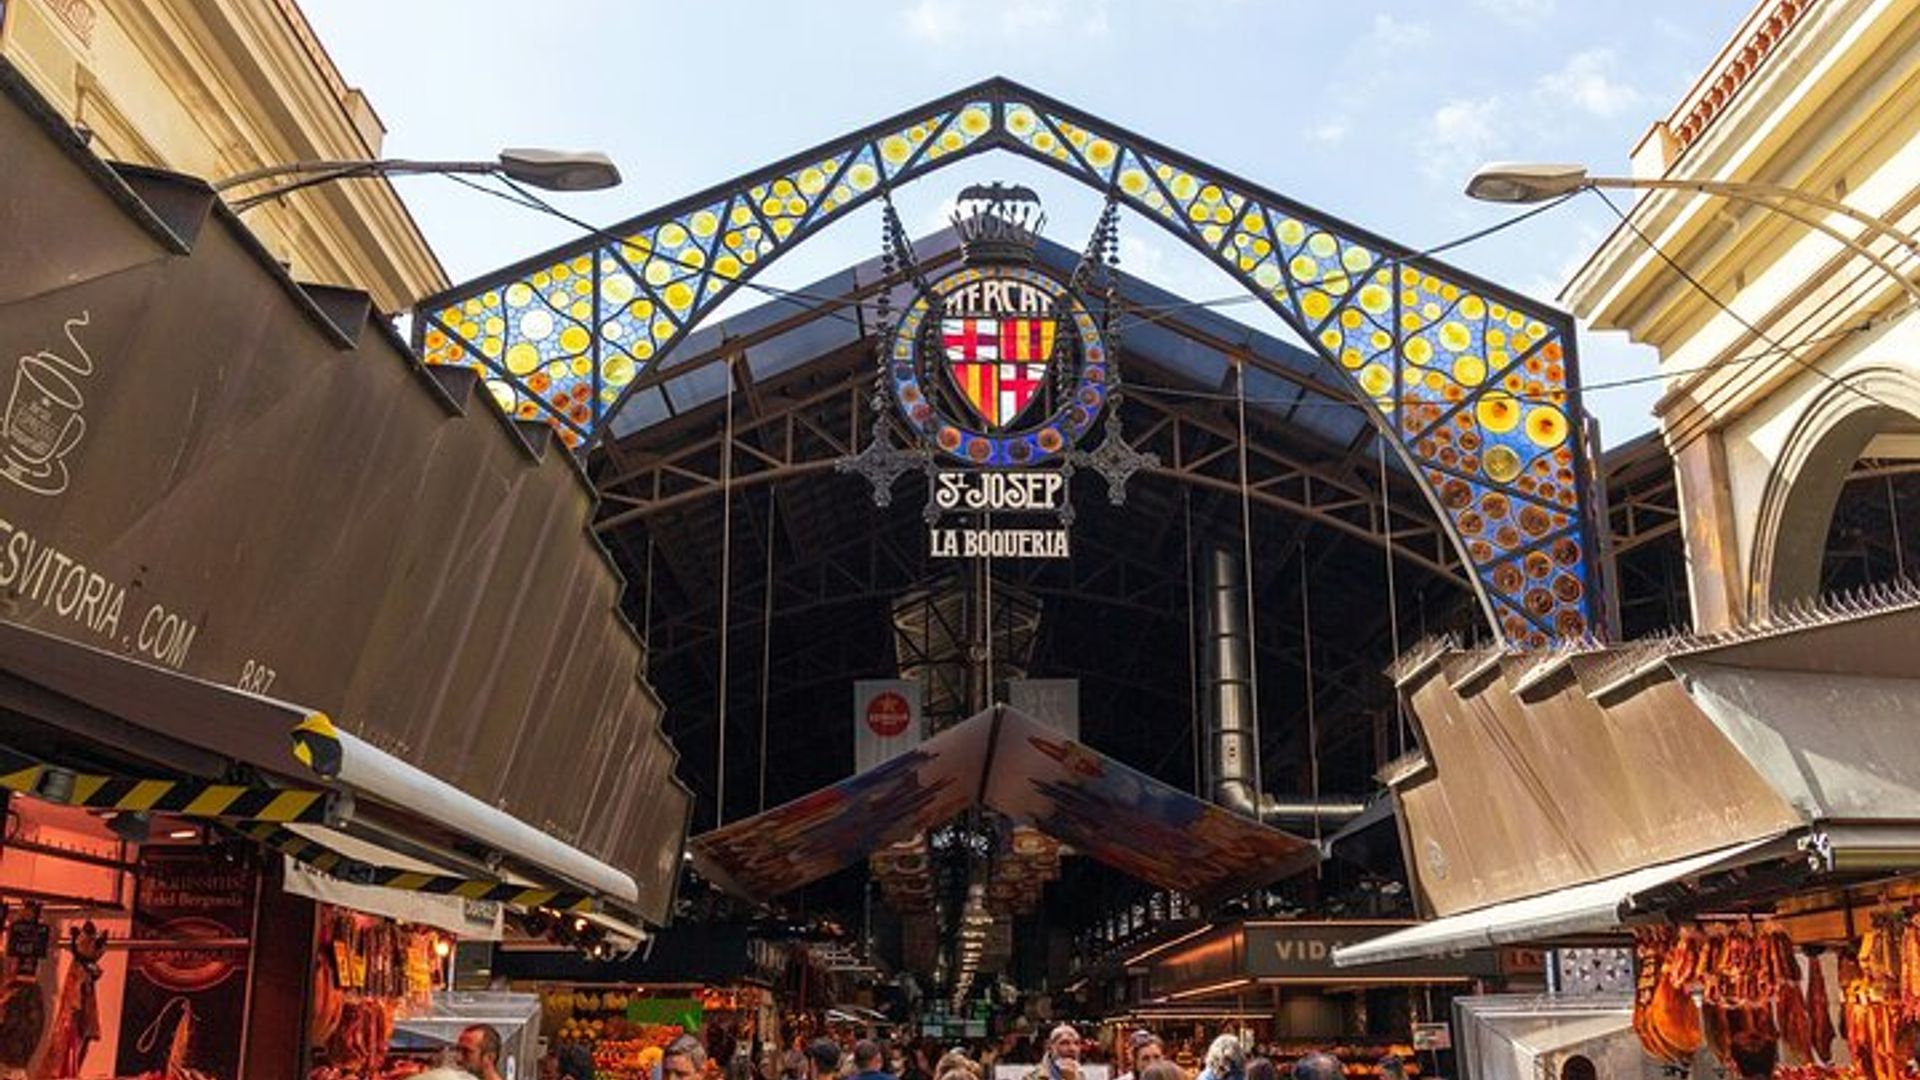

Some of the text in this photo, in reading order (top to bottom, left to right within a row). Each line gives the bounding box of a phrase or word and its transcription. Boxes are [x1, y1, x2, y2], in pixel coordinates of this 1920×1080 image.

[944, 279, 1055, 315] MERCAT
[965, 472, 1063, 509] JOSEP
[930, 529, 1070, 557] LA BOQUERIA
